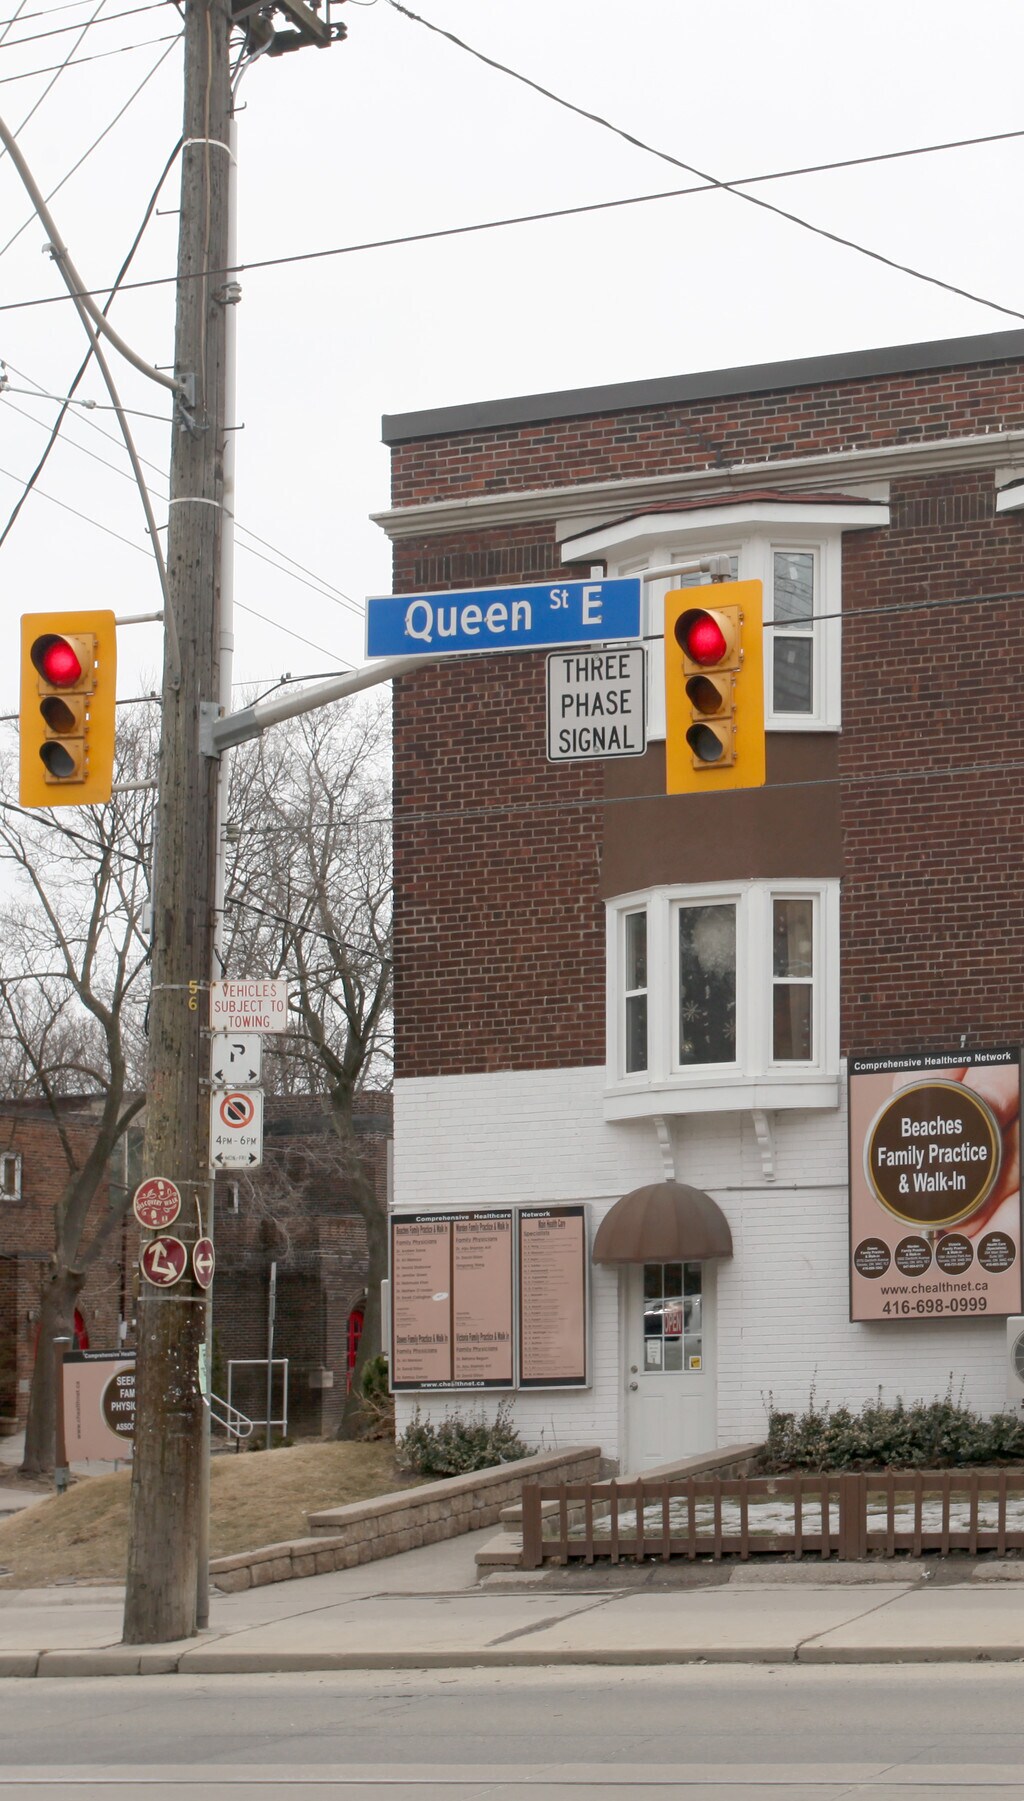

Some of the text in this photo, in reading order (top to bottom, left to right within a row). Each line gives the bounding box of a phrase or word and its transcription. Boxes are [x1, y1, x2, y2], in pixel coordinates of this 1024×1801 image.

[406, 585, 603, 643] Queen St E
[562, 654, 631, 683] THREE
[561, 689, 632, 718] PHASE
[558, 725, 635, 754] SIGNAL
[222, 984, 277, 997] VEHICLES
[214, 1000, 284, 1012] SUBJECT TO
[228, 1015, 270, 1028] TOWING
[854, 1052, 1012, 1071] Comprehensive Healthcare Network
[901, 1116, 963, 1137] Beaches
[216, 1135, 232, 1144] 4PM
[240, 1135, 256, 1145] 6PM
[878, 1142, 988, 1170] Family Practice
[898, 1171, 966, 1194] & Walk-In
[416, 1214, 470, 1222] Comprehensive
[880, 1281, 988, 1295] www.chealthnet.ca
[882, 1296, 988, 1315] 416-698-0999
